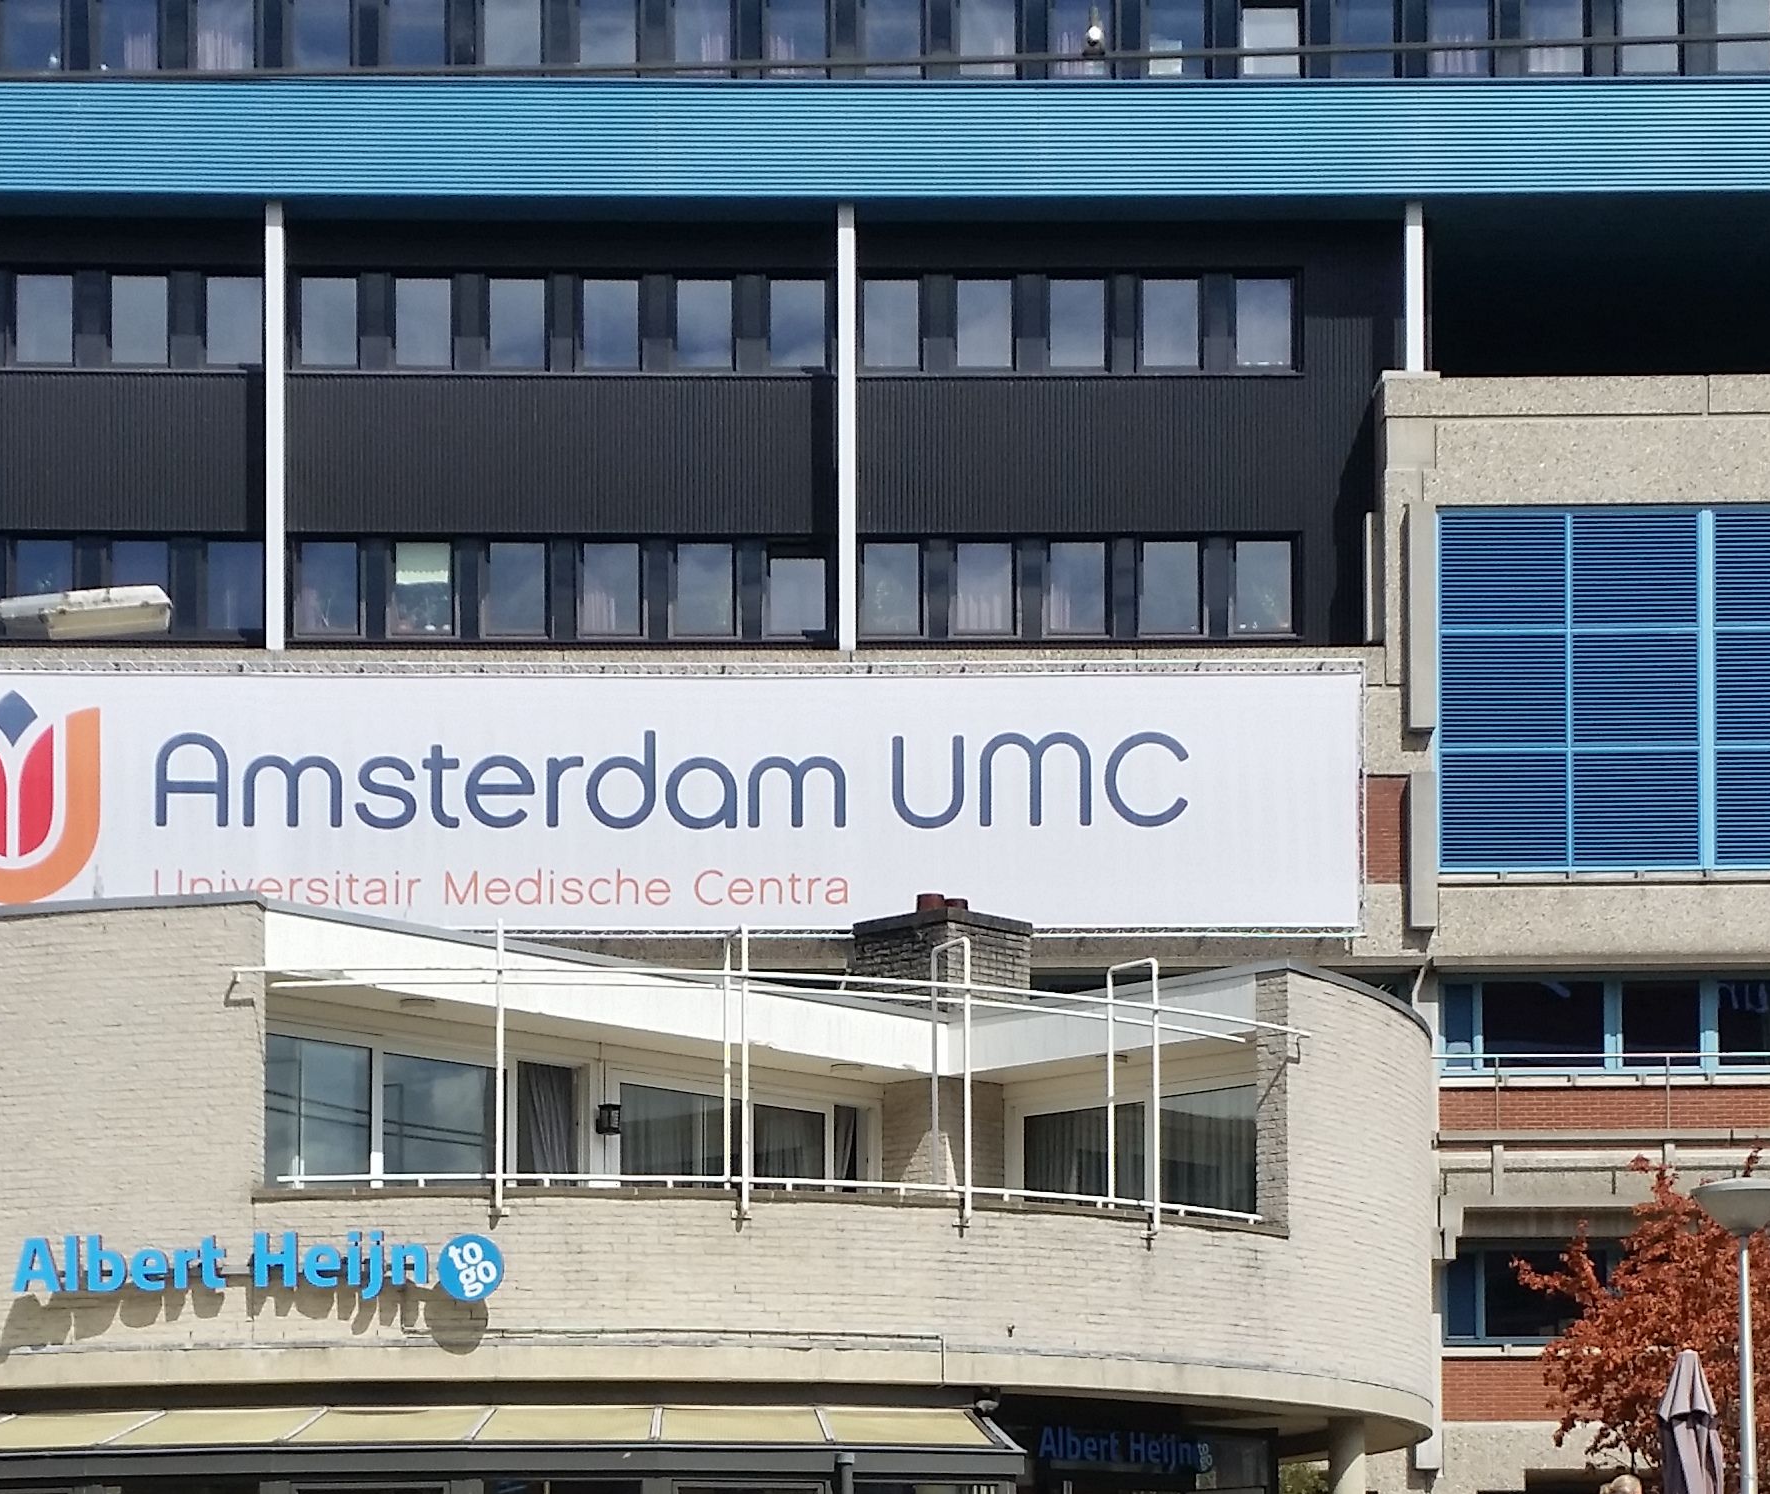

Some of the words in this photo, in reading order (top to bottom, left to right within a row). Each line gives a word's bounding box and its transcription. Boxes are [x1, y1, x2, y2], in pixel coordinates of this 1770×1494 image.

[155, 729, 847, 830] Amsterdam
[891, 731, 1189, 829] UMC
[153, 868, 422, 907] Universitair
[443, 868, 671, 906] Medische
[693, 869, 849, 906] Centra
[12, 1233, 227, 1293] Albert
[253, 1229, 429, 1300] Heijn
[448, 1241, 484, 1271] to
[458, 1260, 497, 1298] go
[1039, 1426, 1120, 1463] Albert
[1130, 1431, 1192, 1472] Heijn
[1197, 1442, 1210, 1456] to
